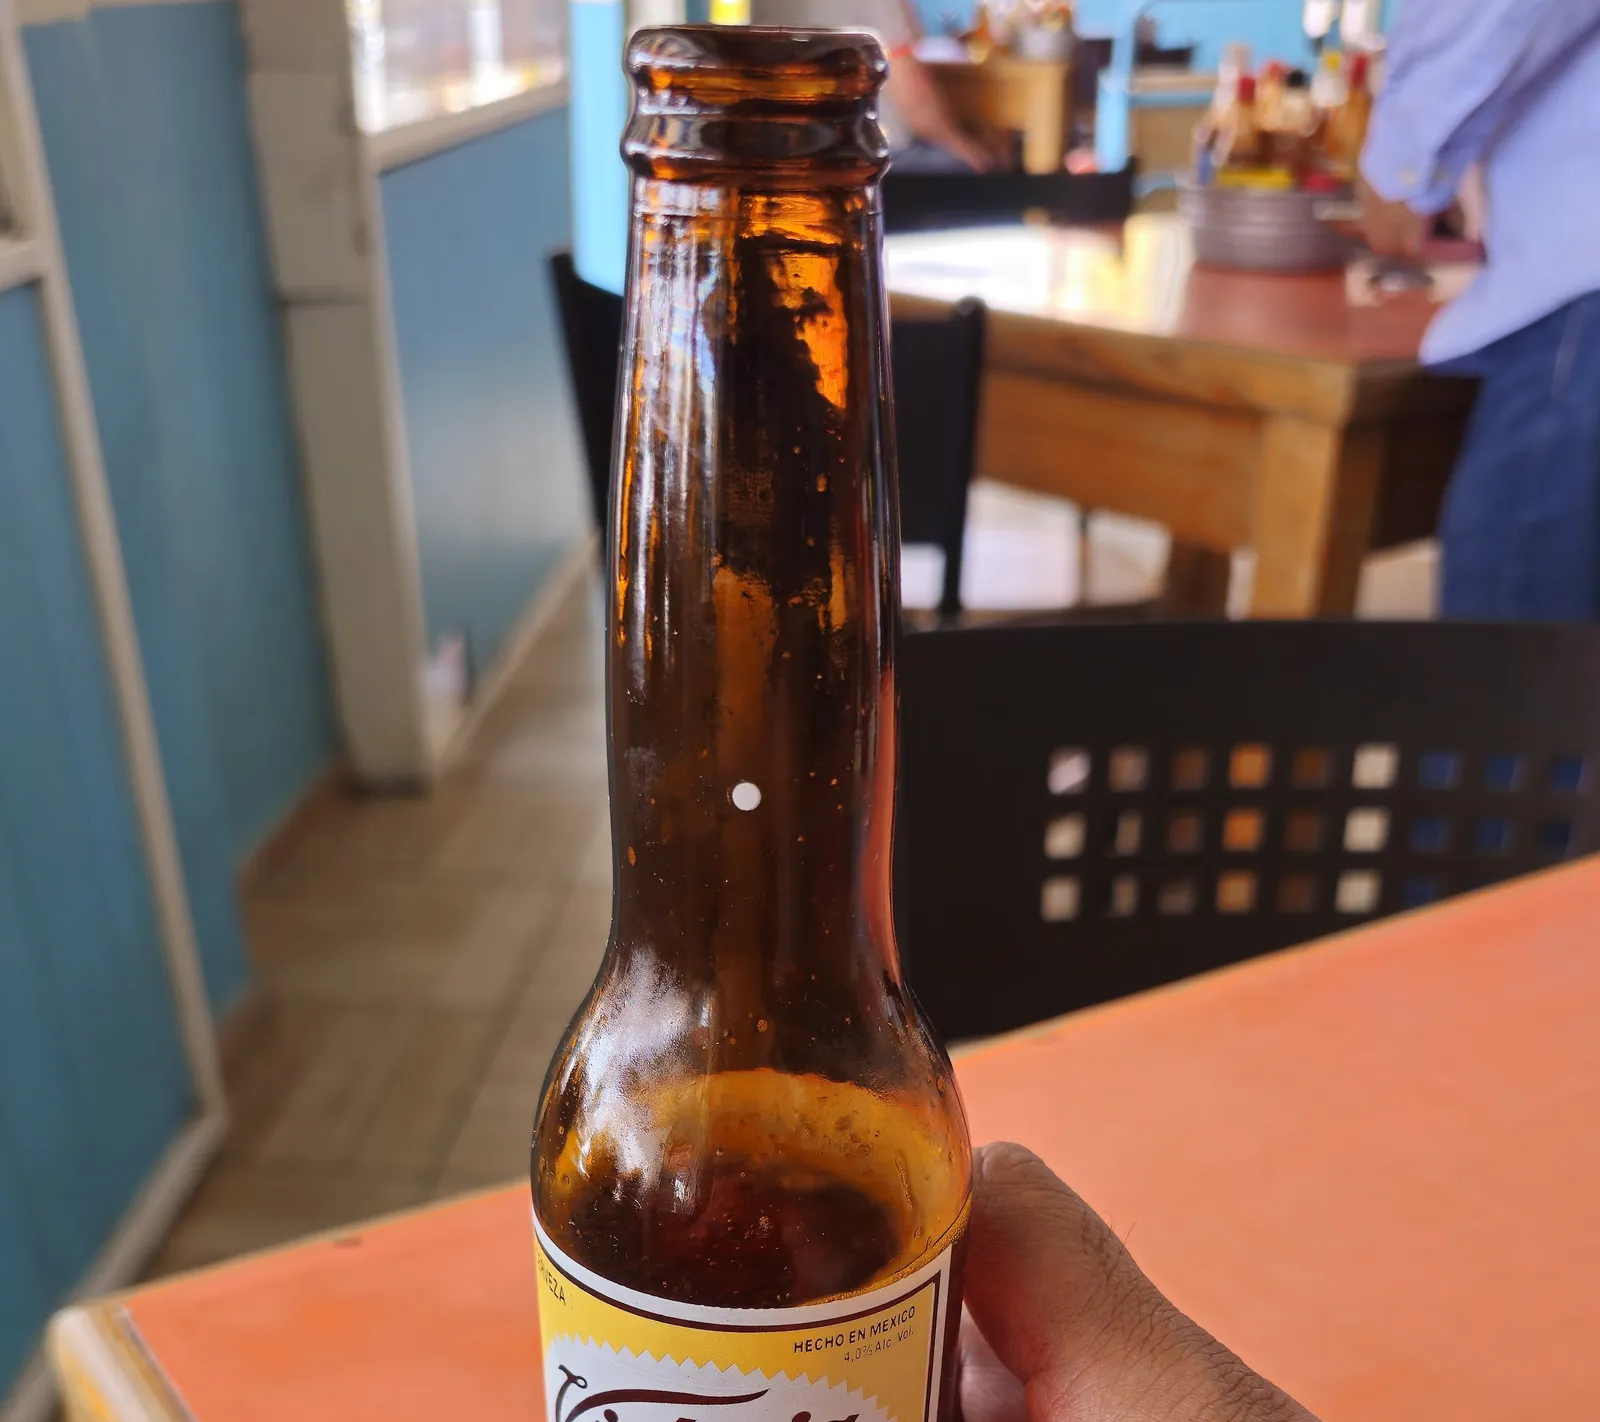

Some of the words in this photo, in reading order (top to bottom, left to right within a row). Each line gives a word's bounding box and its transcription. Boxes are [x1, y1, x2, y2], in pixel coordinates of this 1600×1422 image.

[794, 1334, 845, 1354] HECHO
[849, 1328, 866, 1344] EN
[869, 1305, 916, 1338] MEXICO
[874, 1338, 895, 1353] Alc.
[897, 1326, 914, 1342] Vol.
